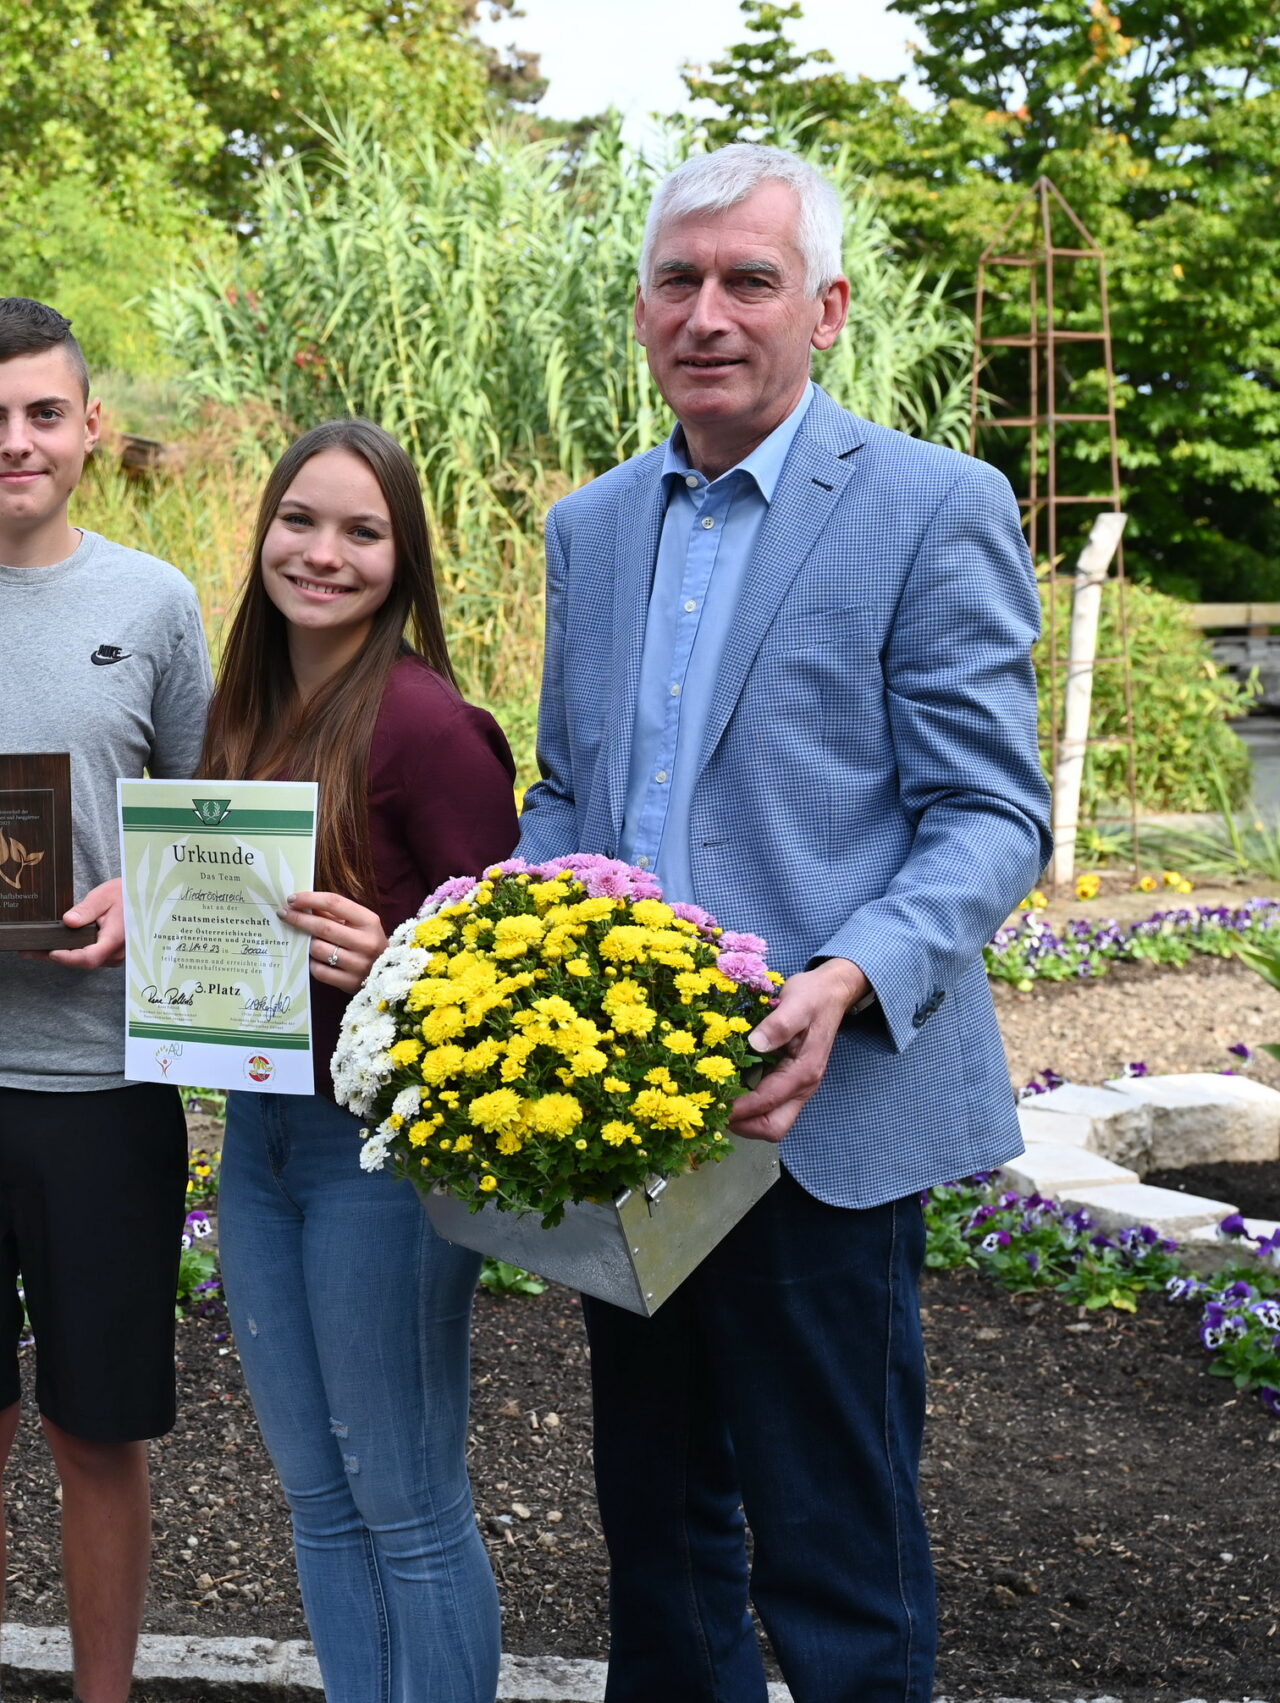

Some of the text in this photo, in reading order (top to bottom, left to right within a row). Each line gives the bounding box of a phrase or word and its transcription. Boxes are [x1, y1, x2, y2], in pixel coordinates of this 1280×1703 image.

[172, 844, 254, 865] Urkunde
[200, 872, 241, 882] Das Team
[171, 914, 270, 926] Staatsmeisterschaft
[195, 927, 262, 938] Österreichischen
[153, 932, 222, 943] Junggärtnerinnen
[241, 937, 290, 948] Junggärtner
[161, 955, 209, 965] teilgenommen
[226, 959, 257, 967] erreichte
[178, 963, 249, 974] Mannschaftswertung
[195, 981, 207, 994] 3.
[208, 983, 241, 997] Platz
